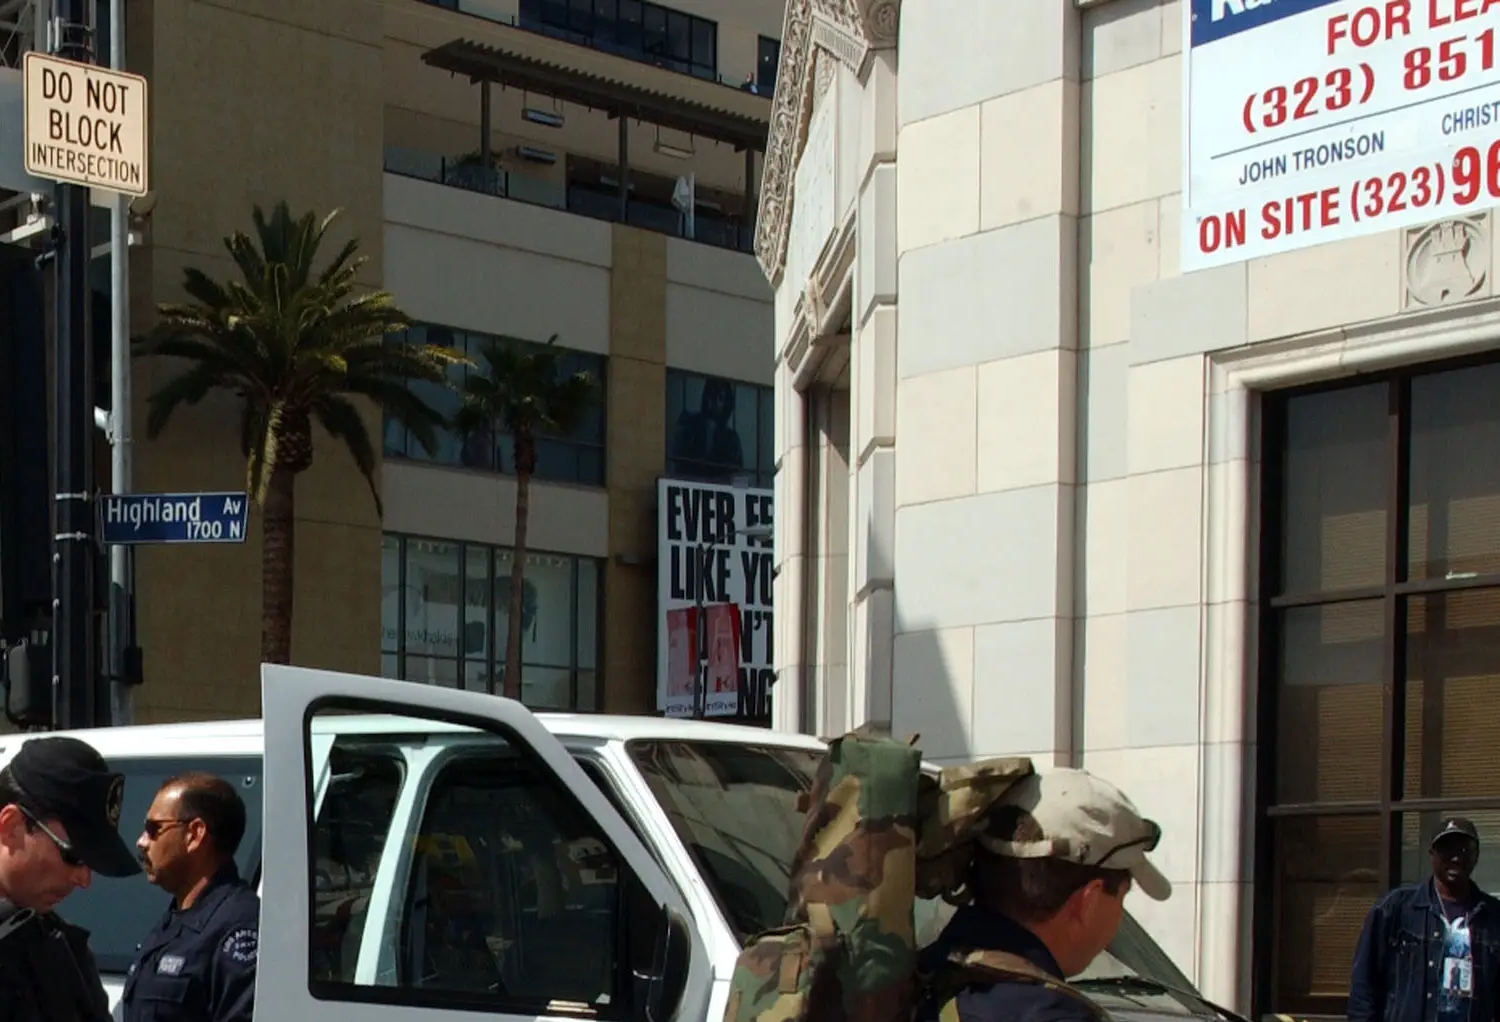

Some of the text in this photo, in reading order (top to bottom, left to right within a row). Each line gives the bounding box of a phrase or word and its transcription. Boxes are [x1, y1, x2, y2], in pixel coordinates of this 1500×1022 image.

[1327, 0, 1411, 55] FOR
[42, 67, 129, 116] DO NOT
[1242, 28, 1494, 133] (323) 851
[49, 108, 122, 154] BLOCK
[1239, 155, 1287, 185] JOHN
[1292, 131, 1385, 173] TRONSON
[32, 142, 140, 184] INTERSECTION
[1199, 208, 1246, 254] ON
[1260, 186, 1340, 240] SITE
[107, 496, 242, 531] Highland Av
[187, 520, 241, 540] 1700 N
[667, 485, 736, 545] EVER
[671, 545, 731, 602] LIKE
